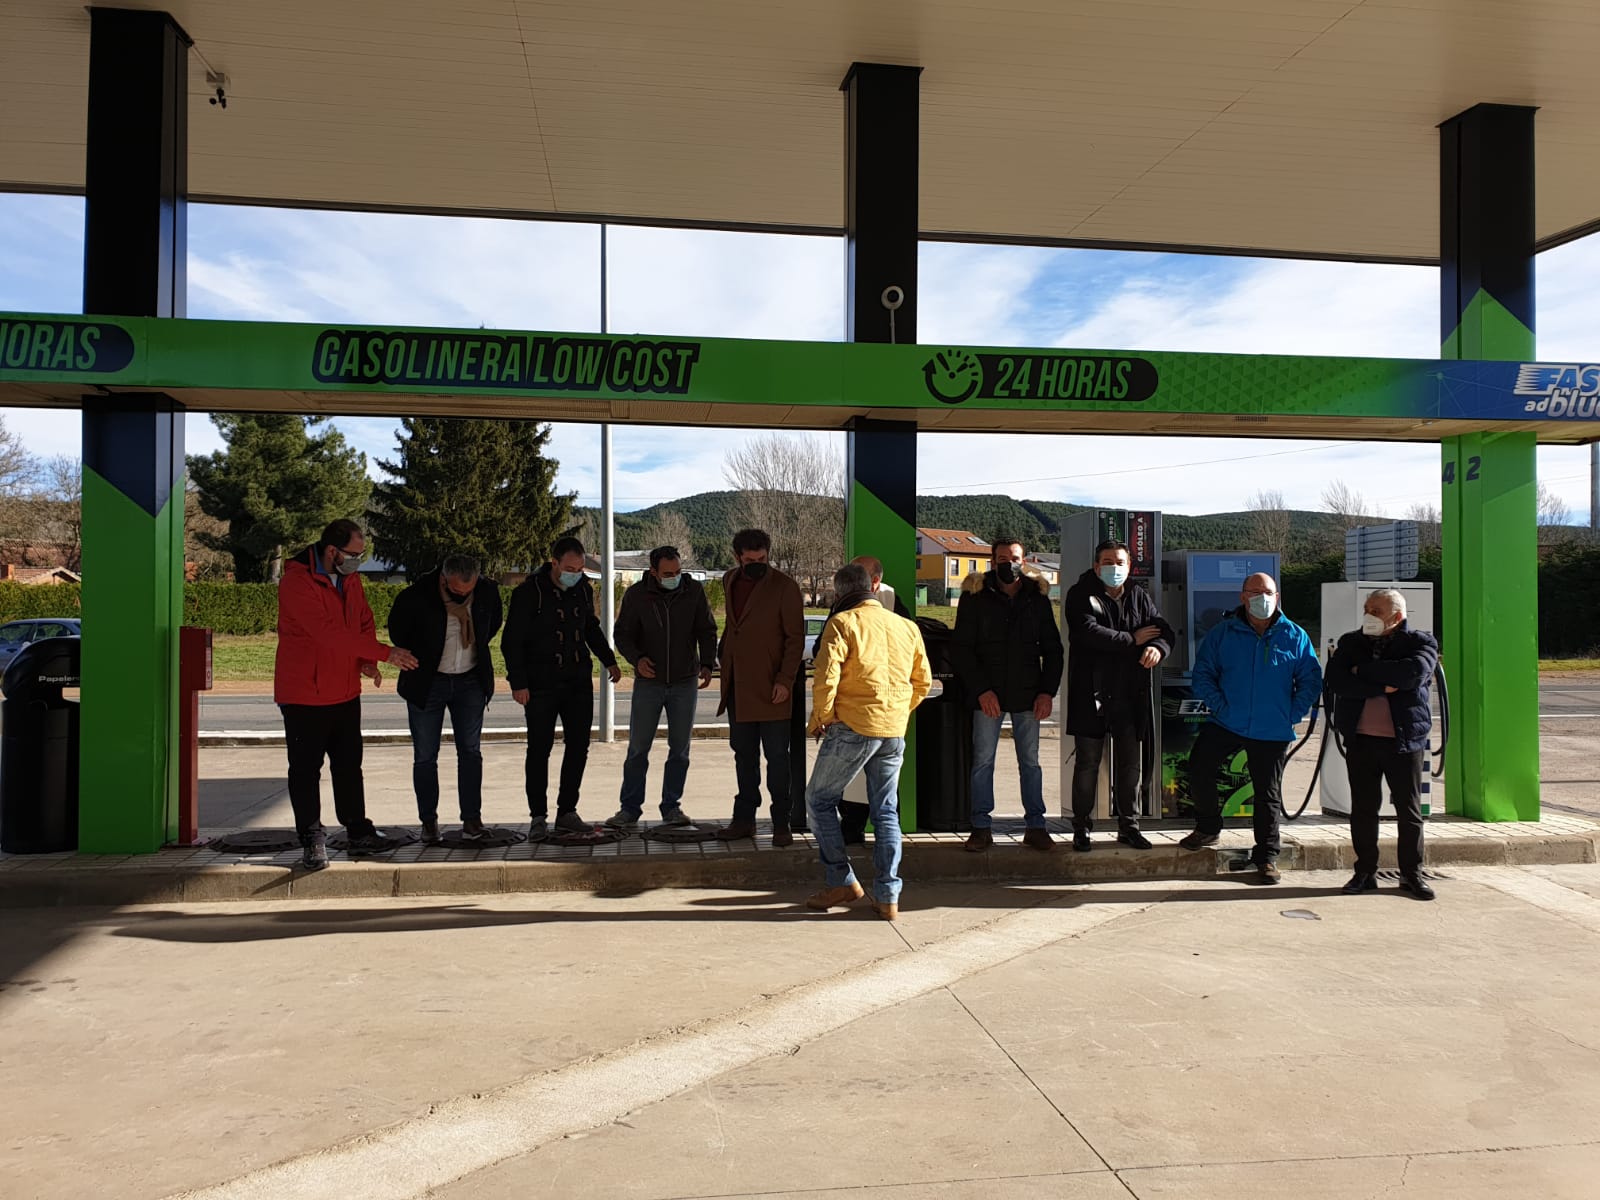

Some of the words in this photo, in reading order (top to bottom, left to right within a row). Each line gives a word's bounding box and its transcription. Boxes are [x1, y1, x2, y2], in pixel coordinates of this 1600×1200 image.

[318, 335, 522, 382] GASOLINERA
[533, 343, 604, 385] LOW
[612, 346, 693, 388] COST
[993, 357, 1033, 397] 24
[1036, 359, 1132, 399] HORAS
[1513, 364, 1600, 396] FAS
[1442, 461, 1456, 485] 4
[1465, 455, 1481, 482] 2
